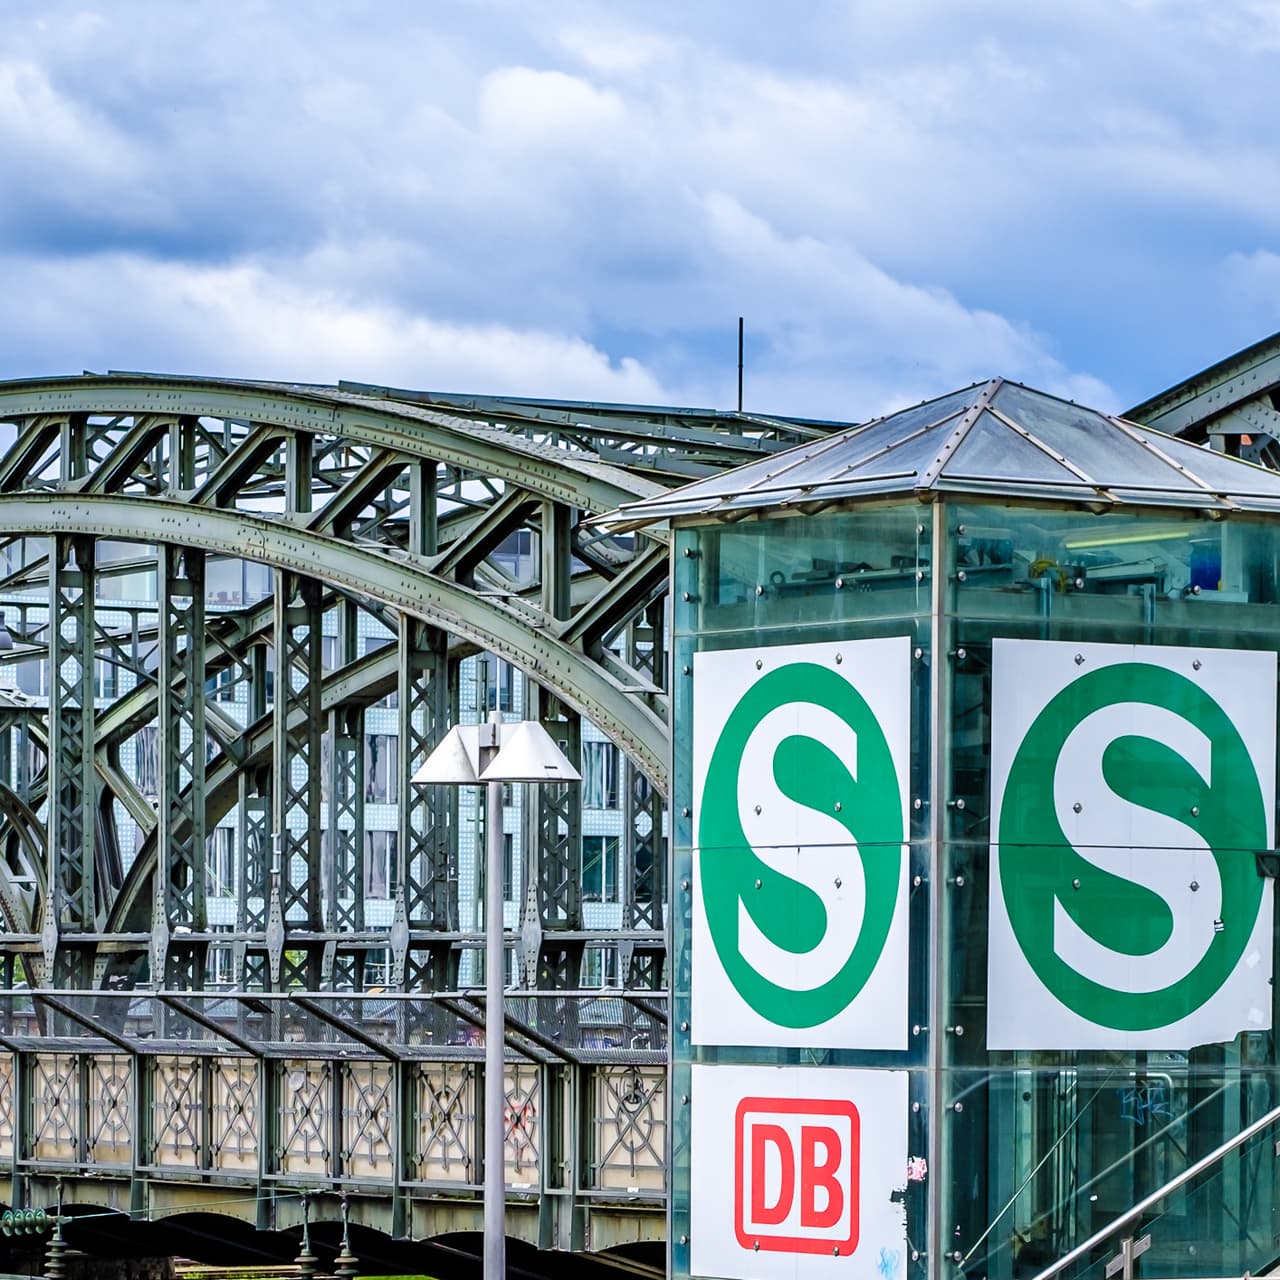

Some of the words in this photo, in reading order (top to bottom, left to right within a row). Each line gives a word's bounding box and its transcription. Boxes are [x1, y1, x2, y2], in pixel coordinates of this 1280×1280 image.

[737, 701, 866, 992] S
[1053, 702, 1222, 993] S
[751, 1123, 843, 1230] DB
